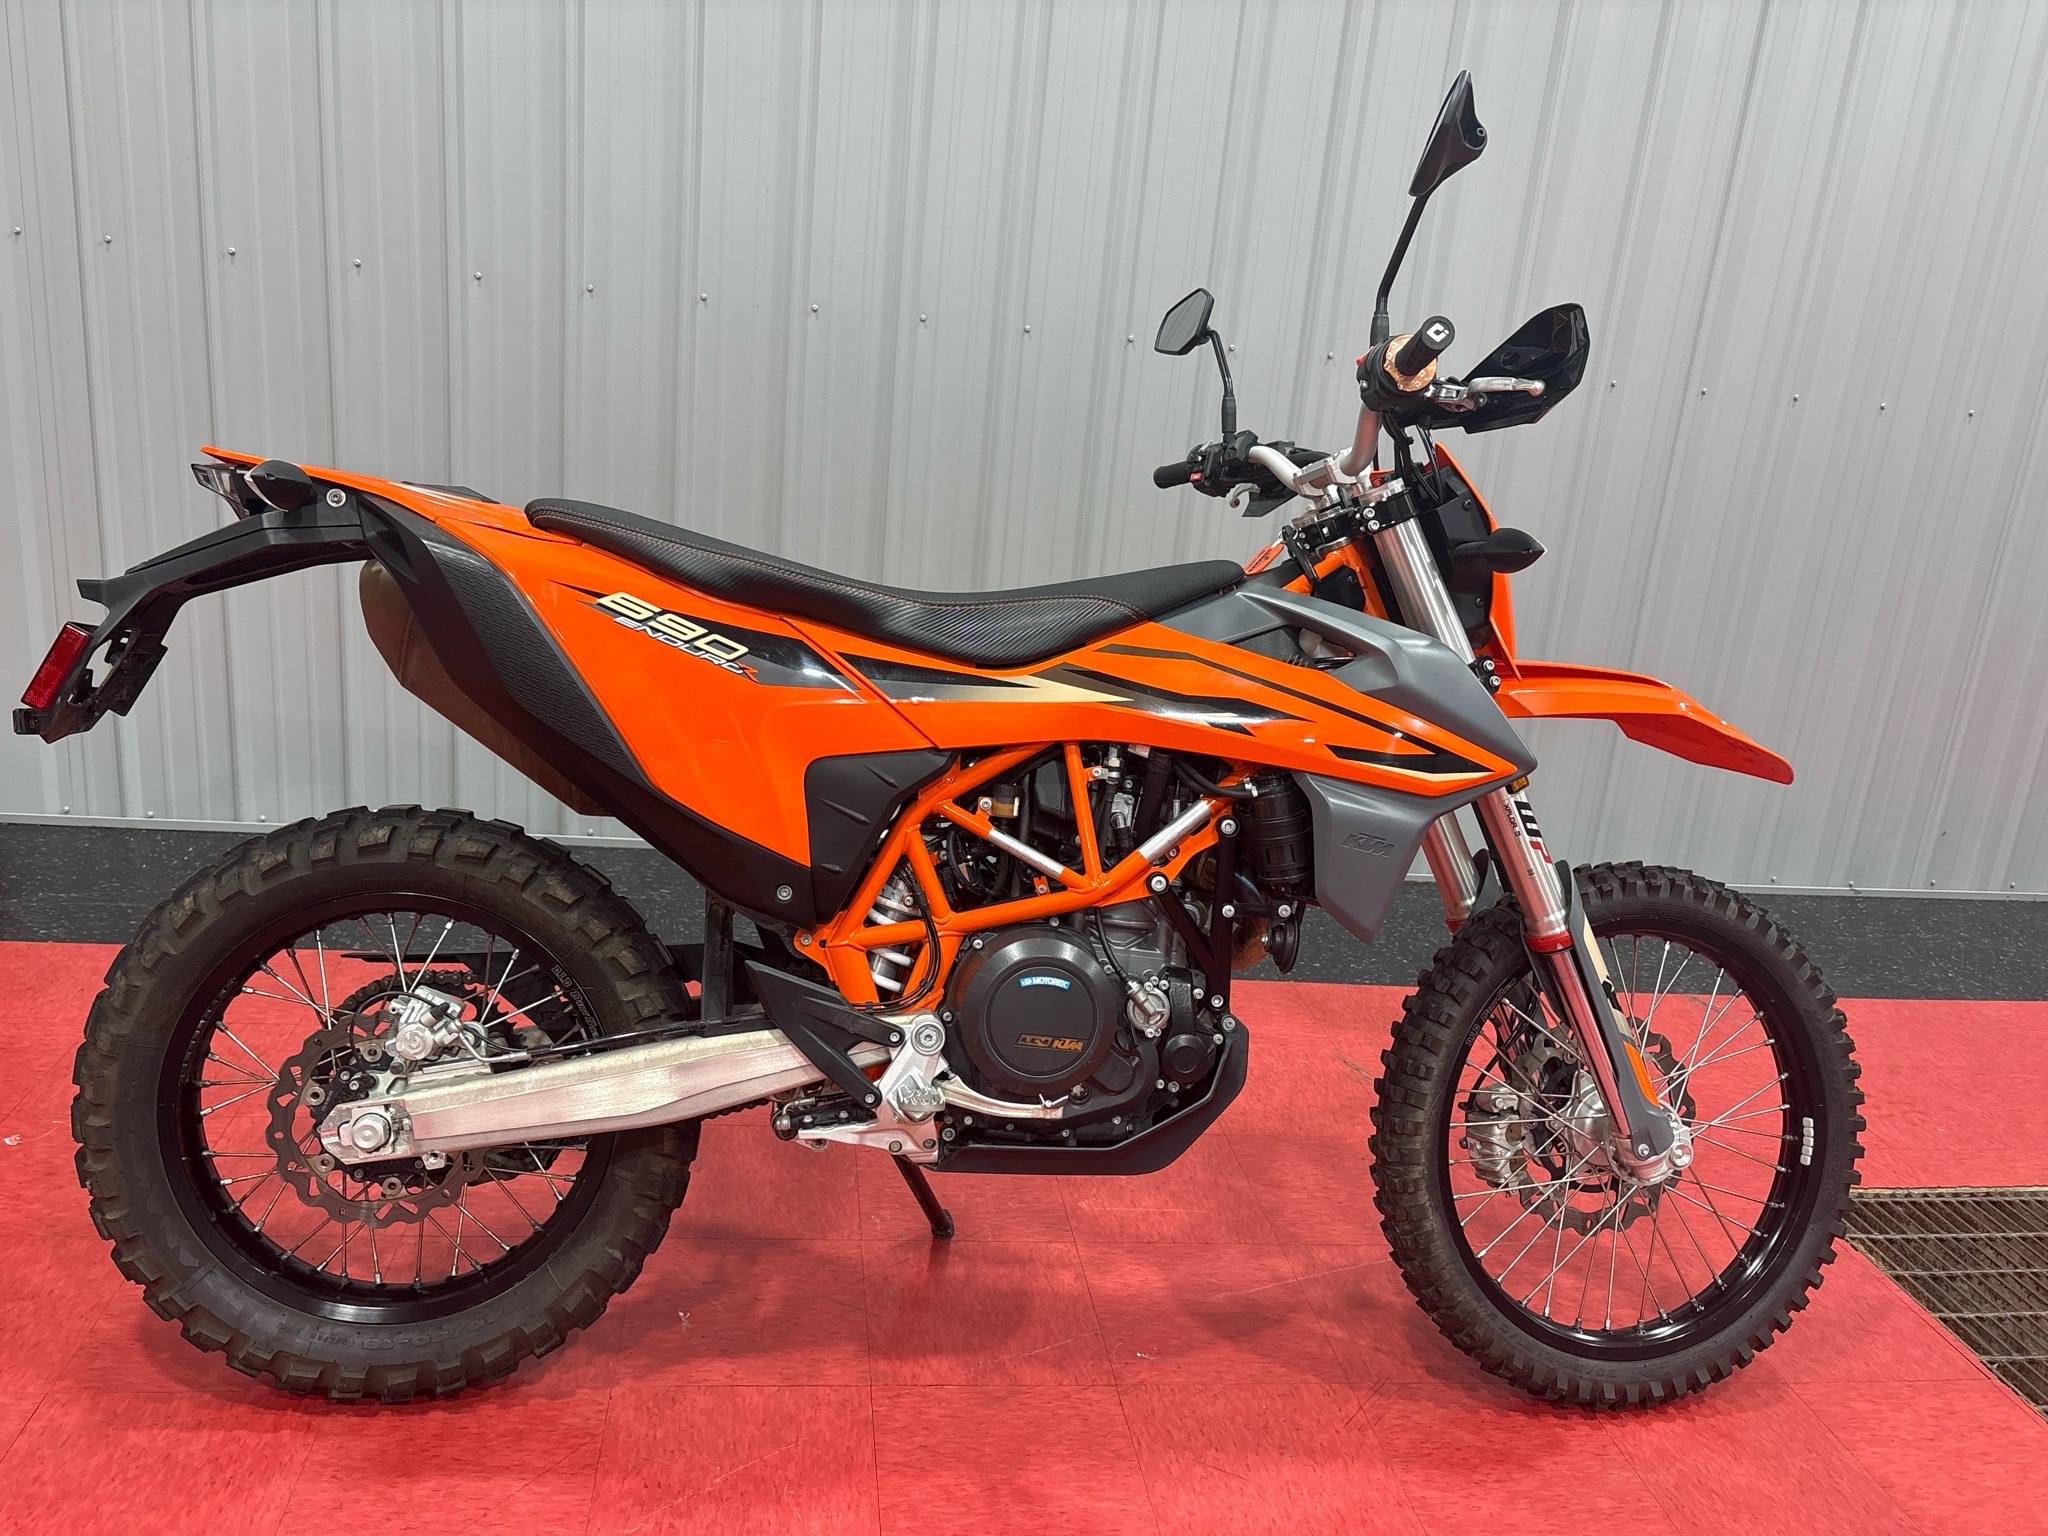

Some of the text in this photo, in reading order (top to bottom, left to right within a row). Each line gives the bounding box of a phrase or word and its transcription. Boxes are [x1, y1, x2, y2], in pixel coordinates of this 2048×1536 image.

[597, 592, 749, 660] 690
[614, 617, 743, 674] ENDURO
[1503, 803, 1518, 830] XPLOR
[1341, 832, 1395, 858] KTM
[1514, 801, 1552, 864] WP
[1032, 977, 1069, 988] MOTOREX
[1052, 1037, 1083, 1051] KTM
